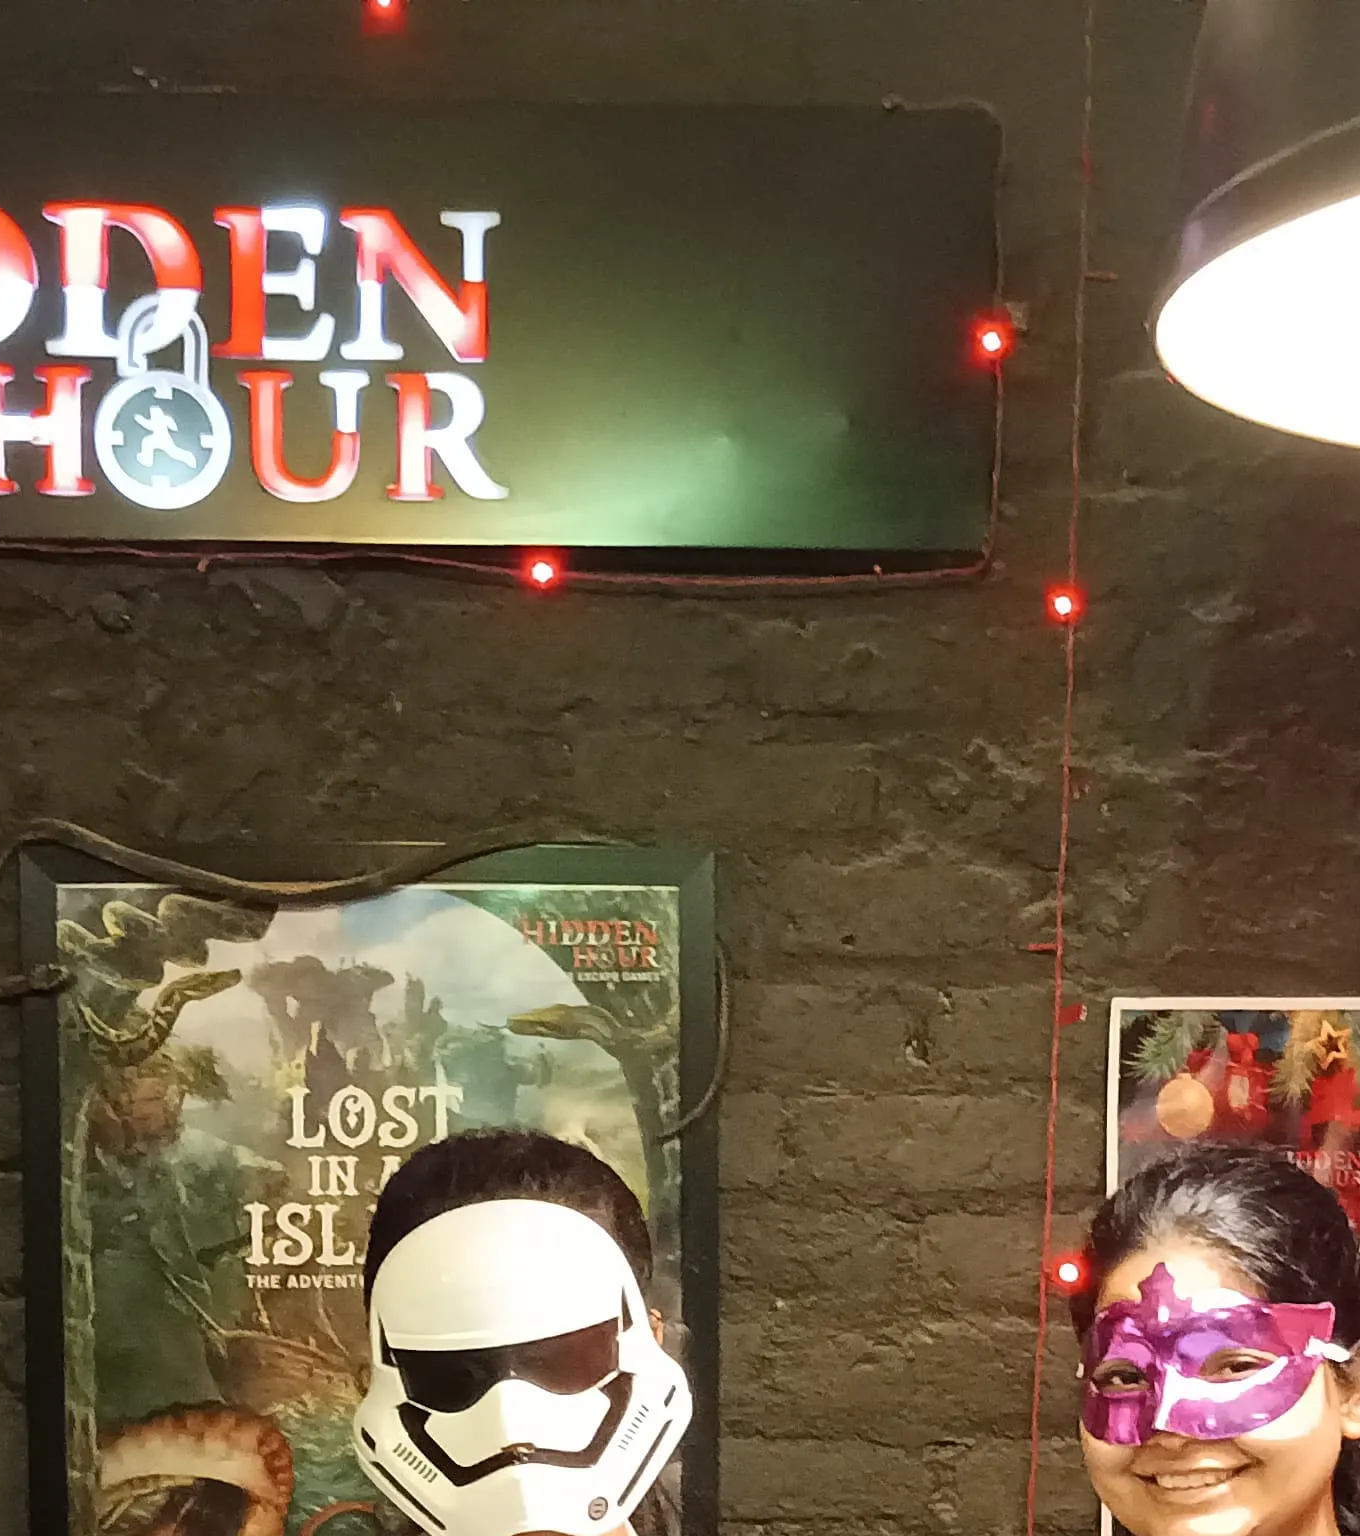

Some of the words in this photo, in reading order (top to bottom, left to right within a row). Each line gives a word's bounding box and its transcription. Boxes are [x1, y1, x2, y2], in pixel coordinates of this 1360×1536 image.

[520, 919, 660, 946] HIDDEN
[572, 945, 660, 969] HOUR
[285, 1084, 464, 1148] LOST
[308, 1155, 360, 1196] IN
[243, 1201, 377, 1267] ISL
[246, 1275, 281, 1289] THE
